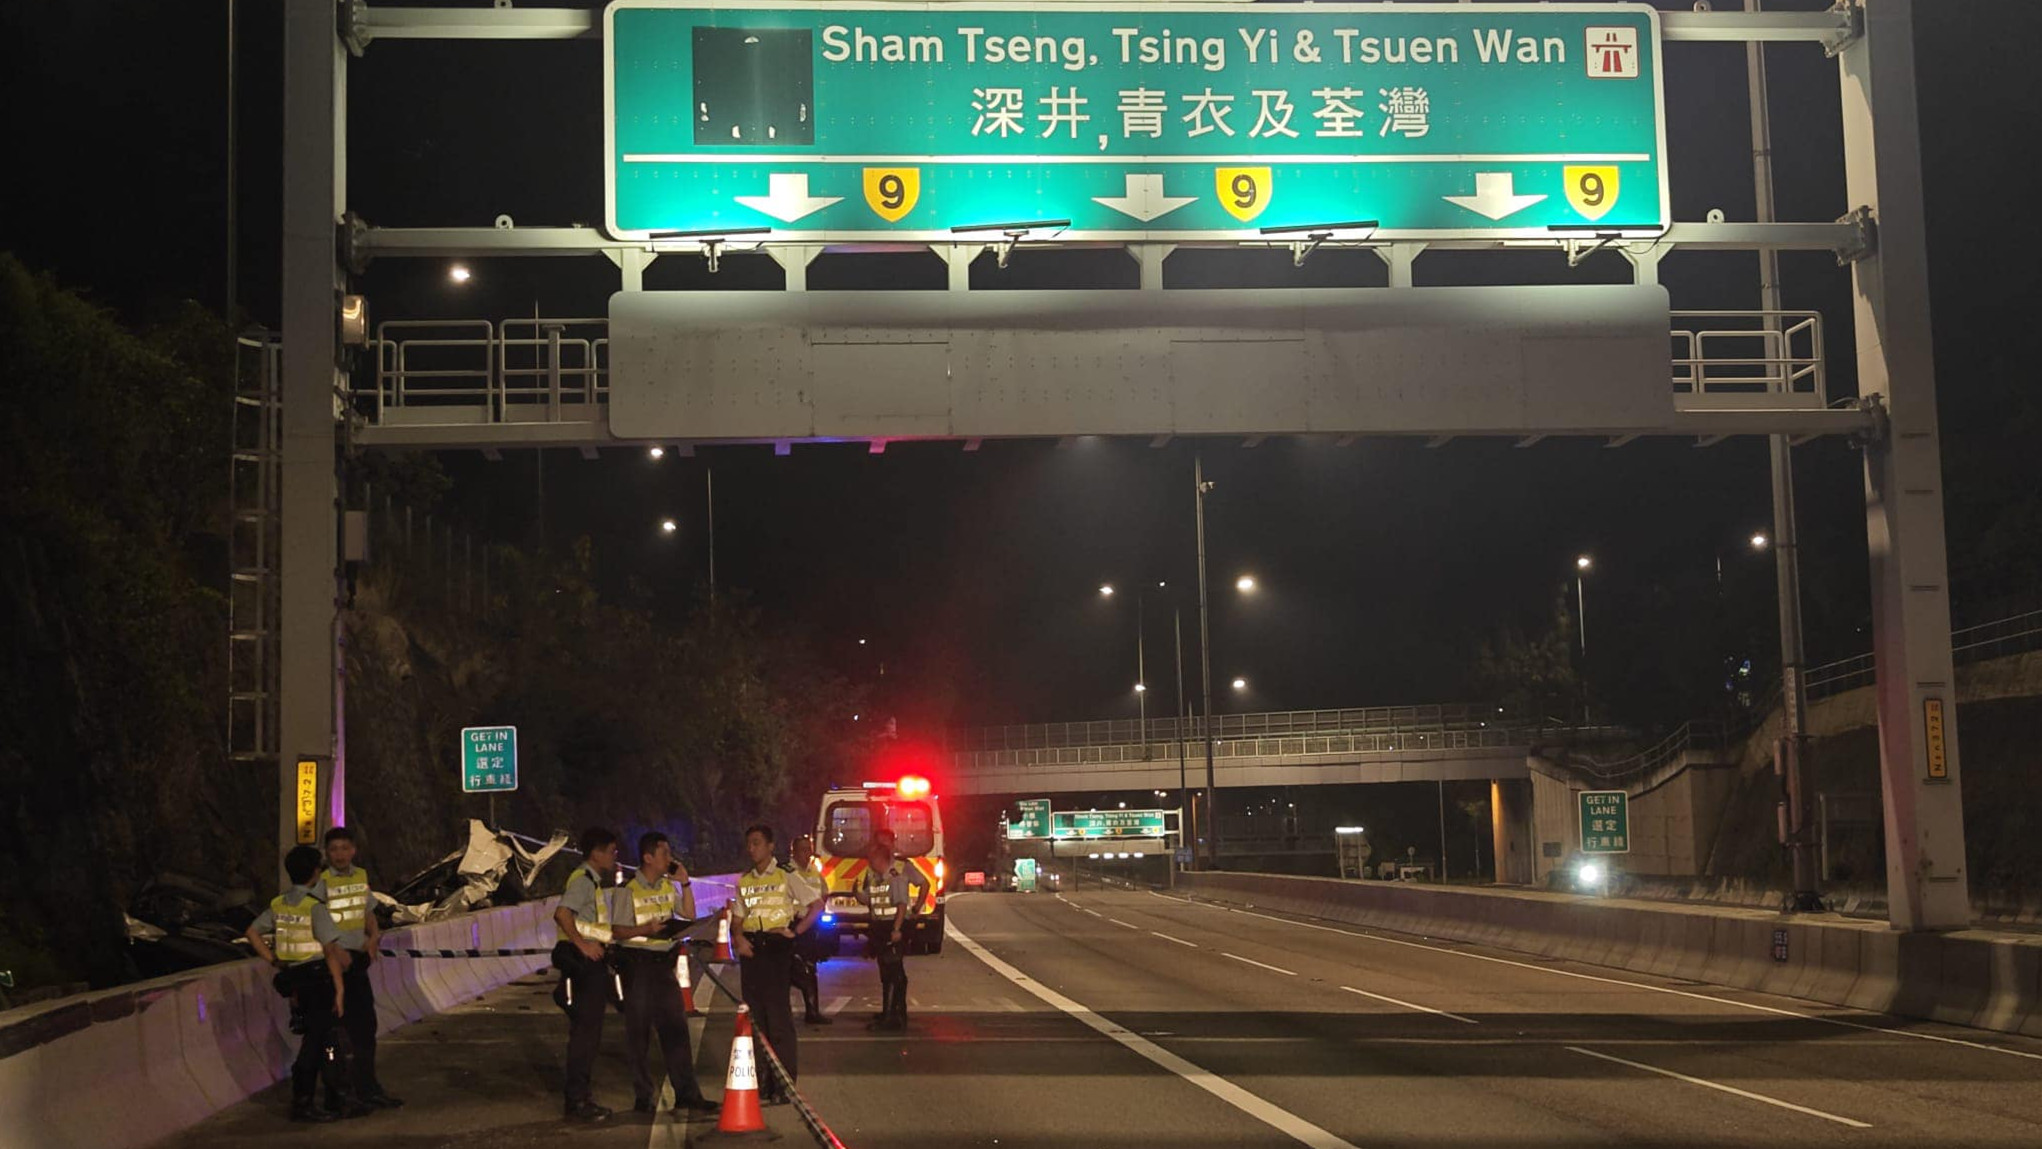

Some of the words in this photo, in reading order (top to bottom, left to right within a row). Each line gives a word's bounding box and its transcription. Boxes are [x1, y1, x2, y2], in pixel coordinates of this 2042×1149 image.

[822, 26, 944, 63] Sham
[958, 28, 1099, 70] Tseng,
[1113, 28, 1226, 71] Tsing
[1240, 28, 1278, 64] Yi
[1293, 29, 1322, 63] &
[1334, 29, 1459, 63] Tsuen
[1474, 29, 1566, 63] Wan
[879, 175, 906, 210] 9
[1231, 174, 1258, 208] 9
[1579, 172, 1605, 206] 9
[470, 732, 492, 741] GET
[495, 731, 508, 741] IN
[475, 743, 504, 752] LANE
[1586, 795, 1606, 804] GET
[1608, 795, 1620, 804] IN
[1590, 806, 1617, 815] LANE
[730, 1065, 756, 1078] POLIC
